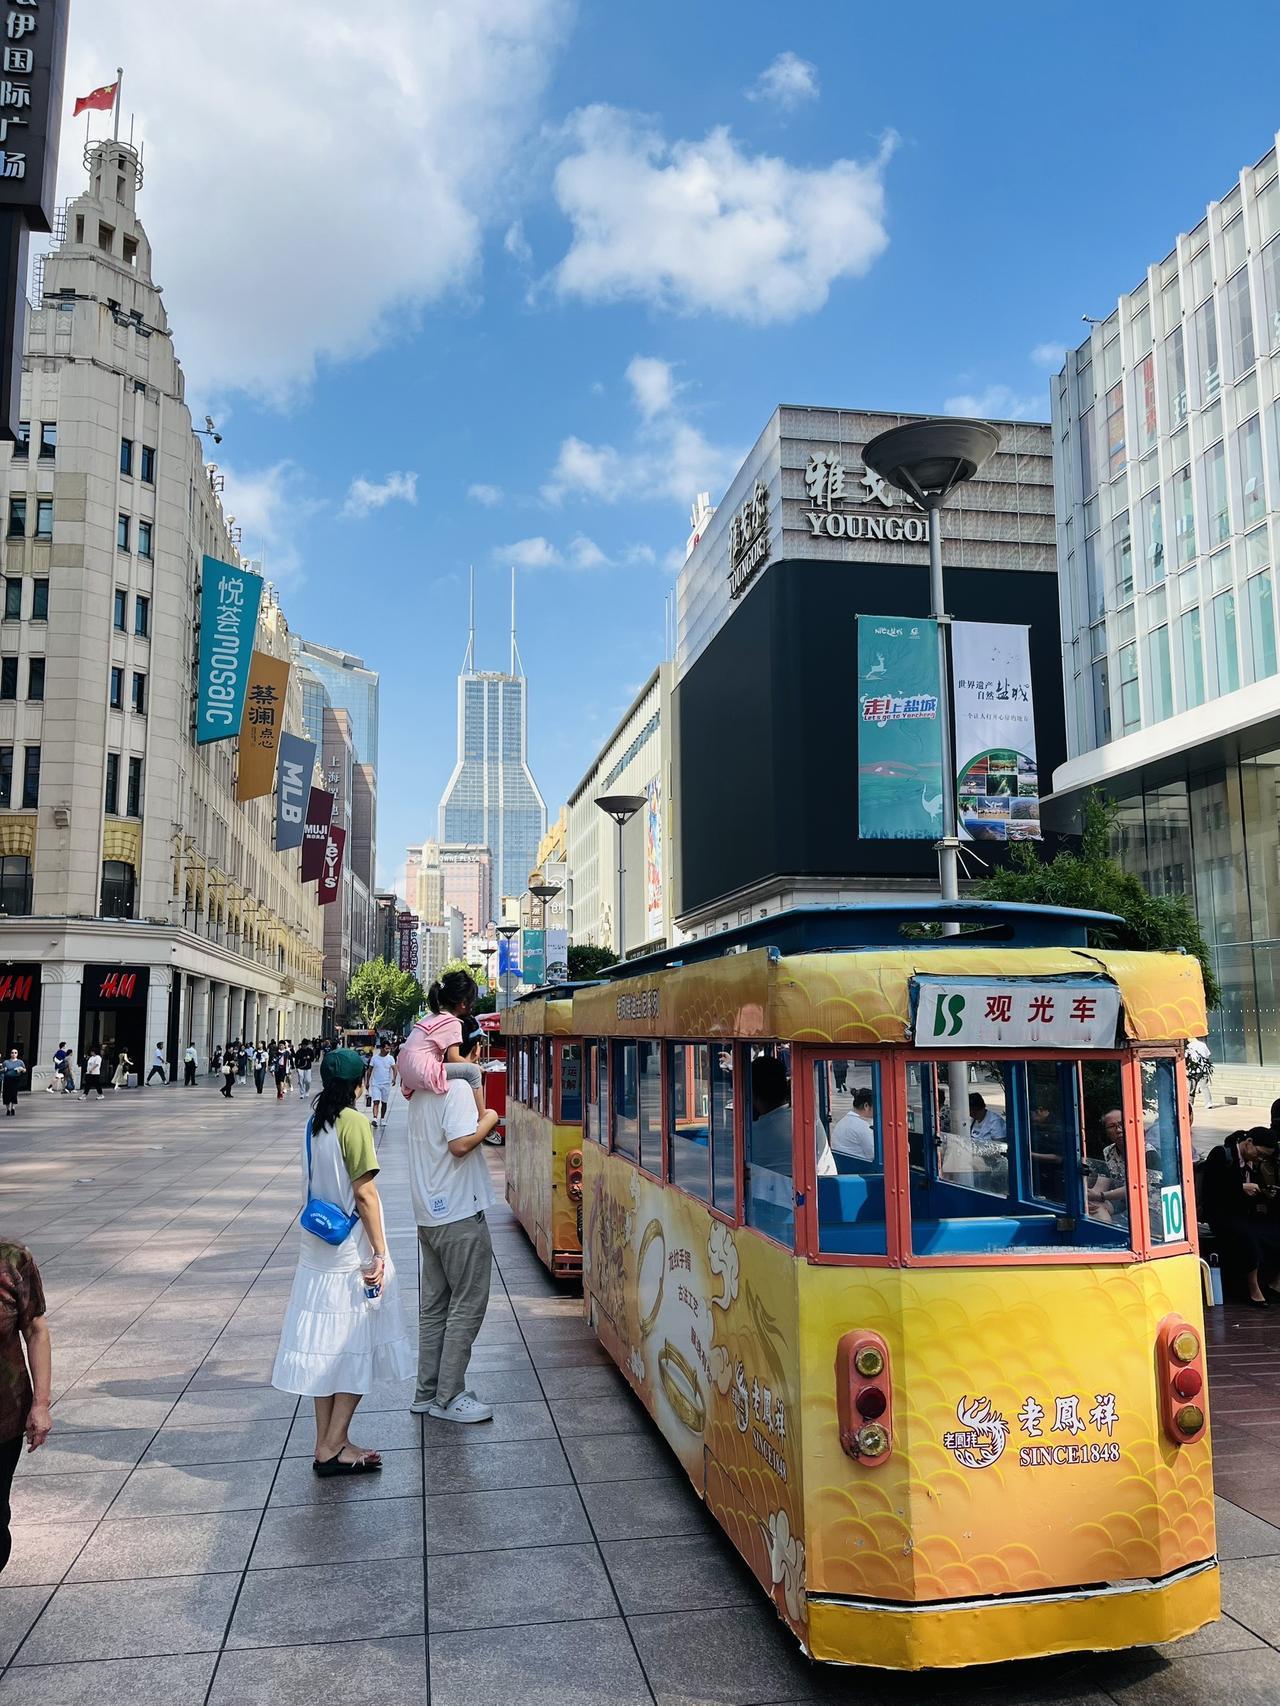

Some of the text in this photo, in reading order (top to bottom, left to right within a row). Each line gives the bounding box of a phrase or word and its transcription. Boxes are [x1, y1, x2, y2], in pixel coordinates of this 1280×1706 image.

[805, 450, 926, 513] 雅戈
[282, 760, 304, 824] MLB
[304, 824, 328, 835] MUJI
[100, 972, 137, 999] H&M
[984, 995, 1097, 1024] 观光车
[1162, 1192, 1183, 1236] 10
